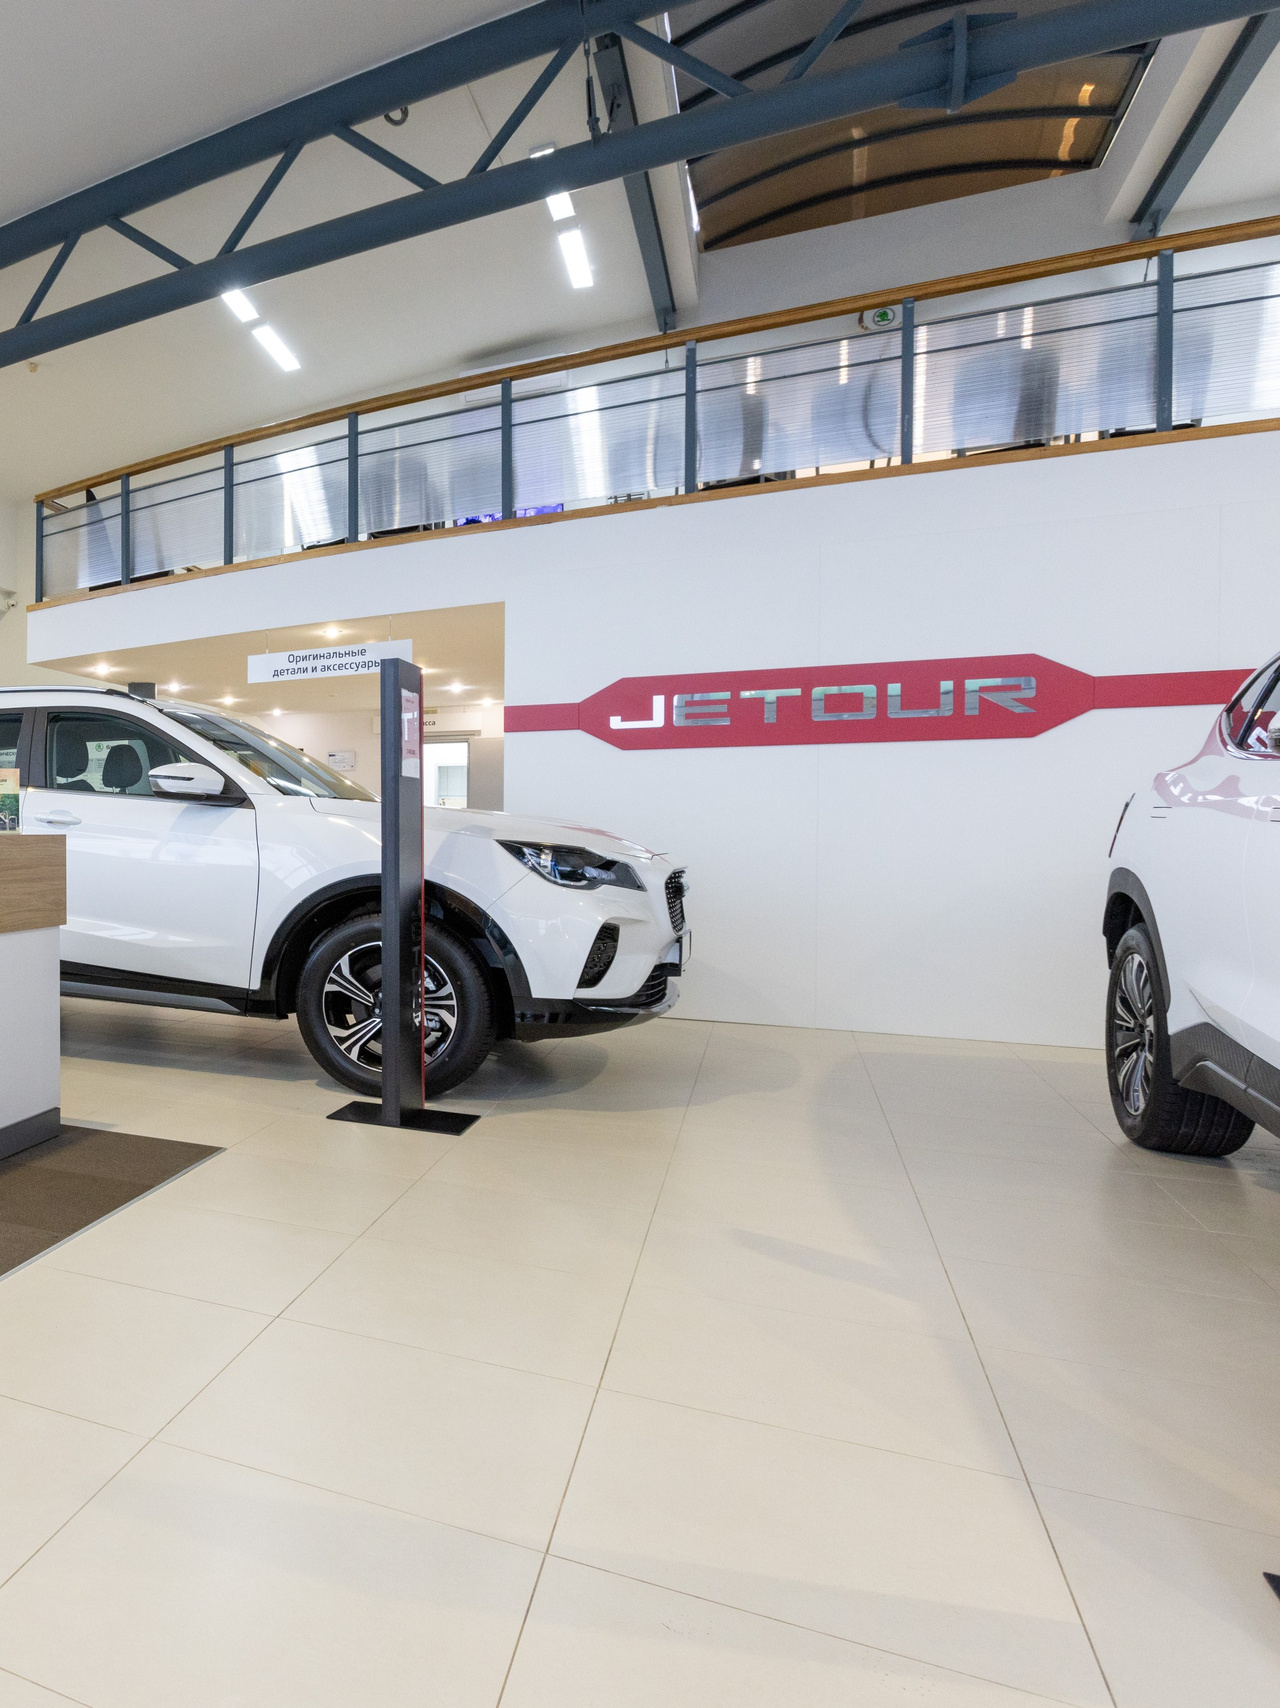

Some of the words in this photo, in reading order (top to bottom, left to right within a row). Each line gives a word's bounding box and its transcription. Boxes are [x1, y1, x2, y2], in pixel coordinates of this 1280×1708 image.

[287, 648, 367, 665] Оригинальные
[273, 666, 308, 678] детали
[311, 665, 318, 673] и
[609, 676, 1037, 729] JETOUR
